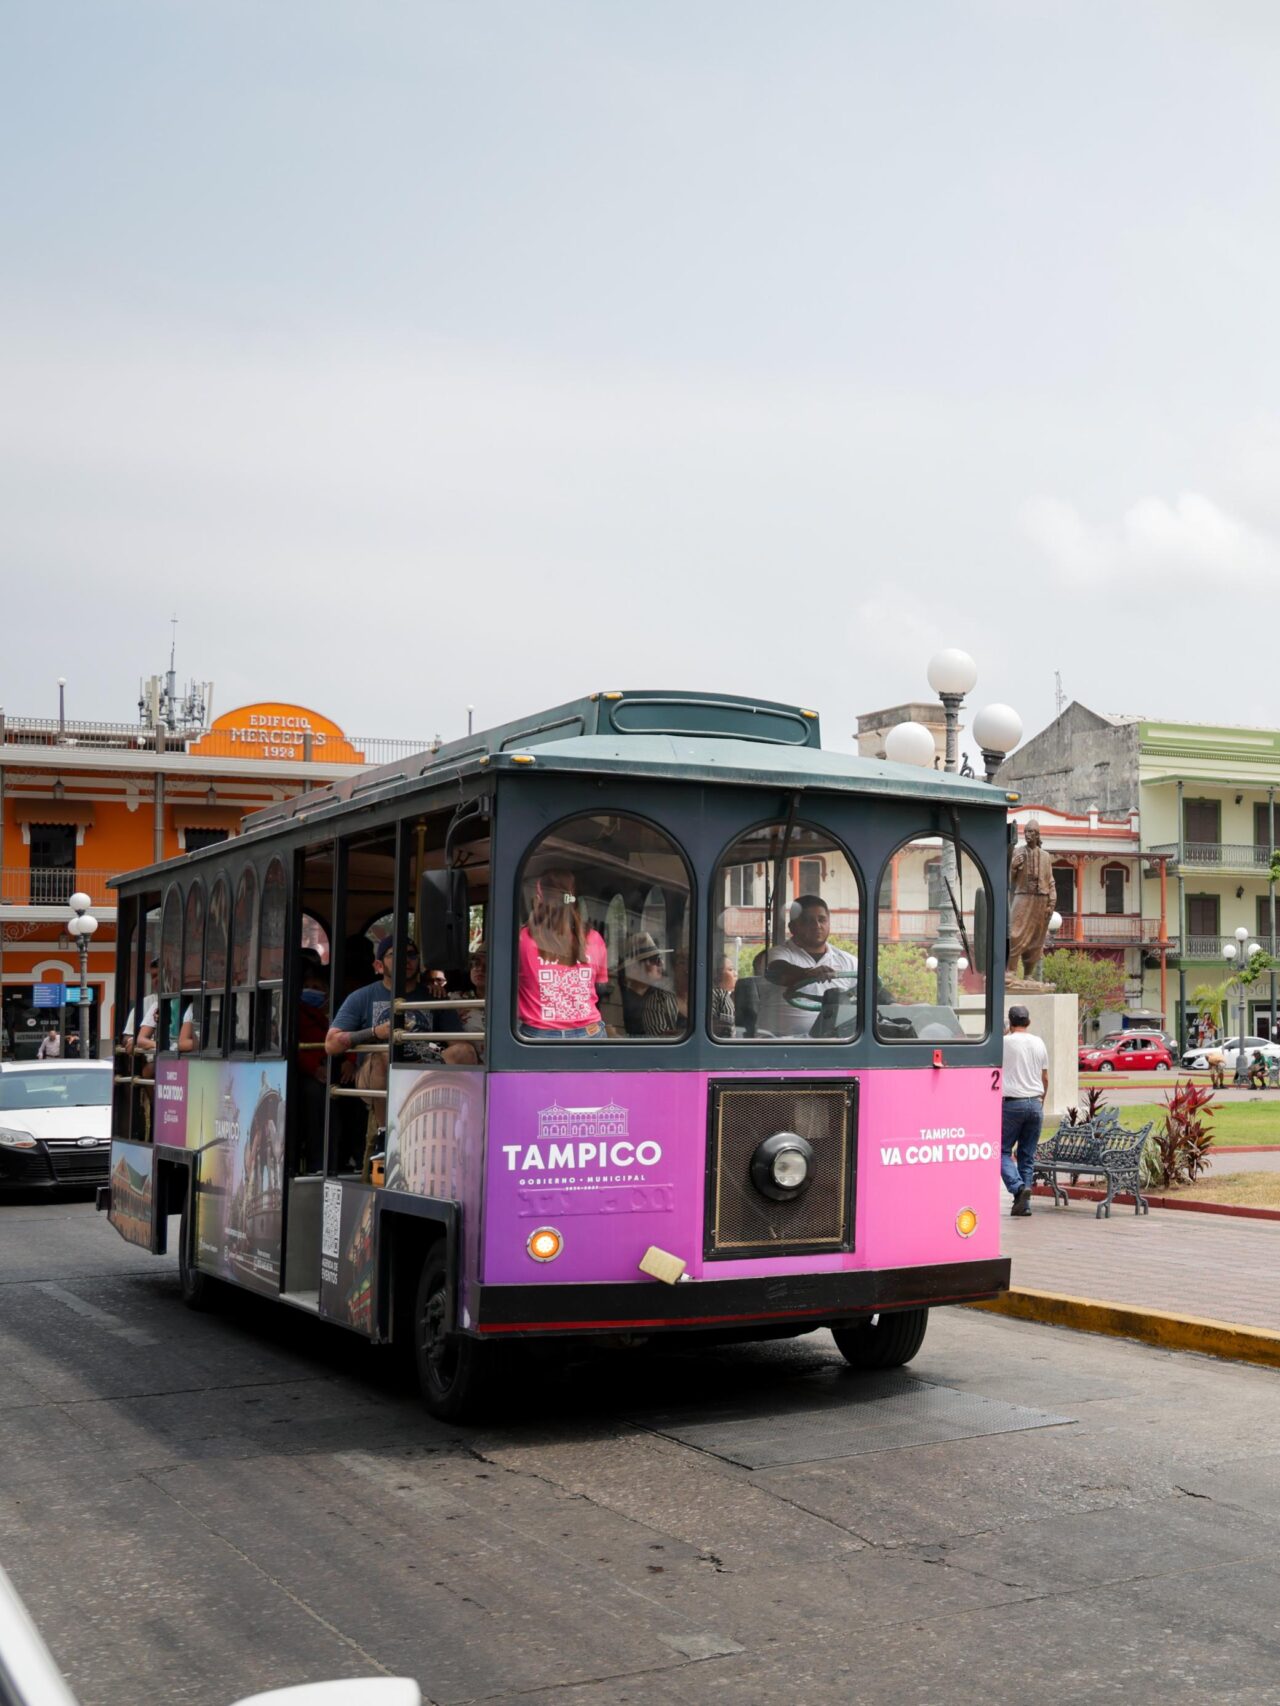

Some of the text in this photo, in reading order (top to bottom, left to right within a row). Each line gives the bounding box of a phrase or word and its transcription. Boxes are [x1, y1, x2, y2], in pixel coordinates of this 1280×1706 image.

[250, 715, 309, 728] EDIFICIO
[231, 728, 326, 745] MERCEDS
[263, 746, 295, 758] 1928
[991, 1070, 1000, 1091] 2
[920, 1127, 965, 1140] TAMPICO
[502, 1140, 662, 1171] TAMPICO
[880, 1142, 992, 1166] VA CON TODO
[519, 1174, 646, 1186] GOBIERNO MUNICIPAL
